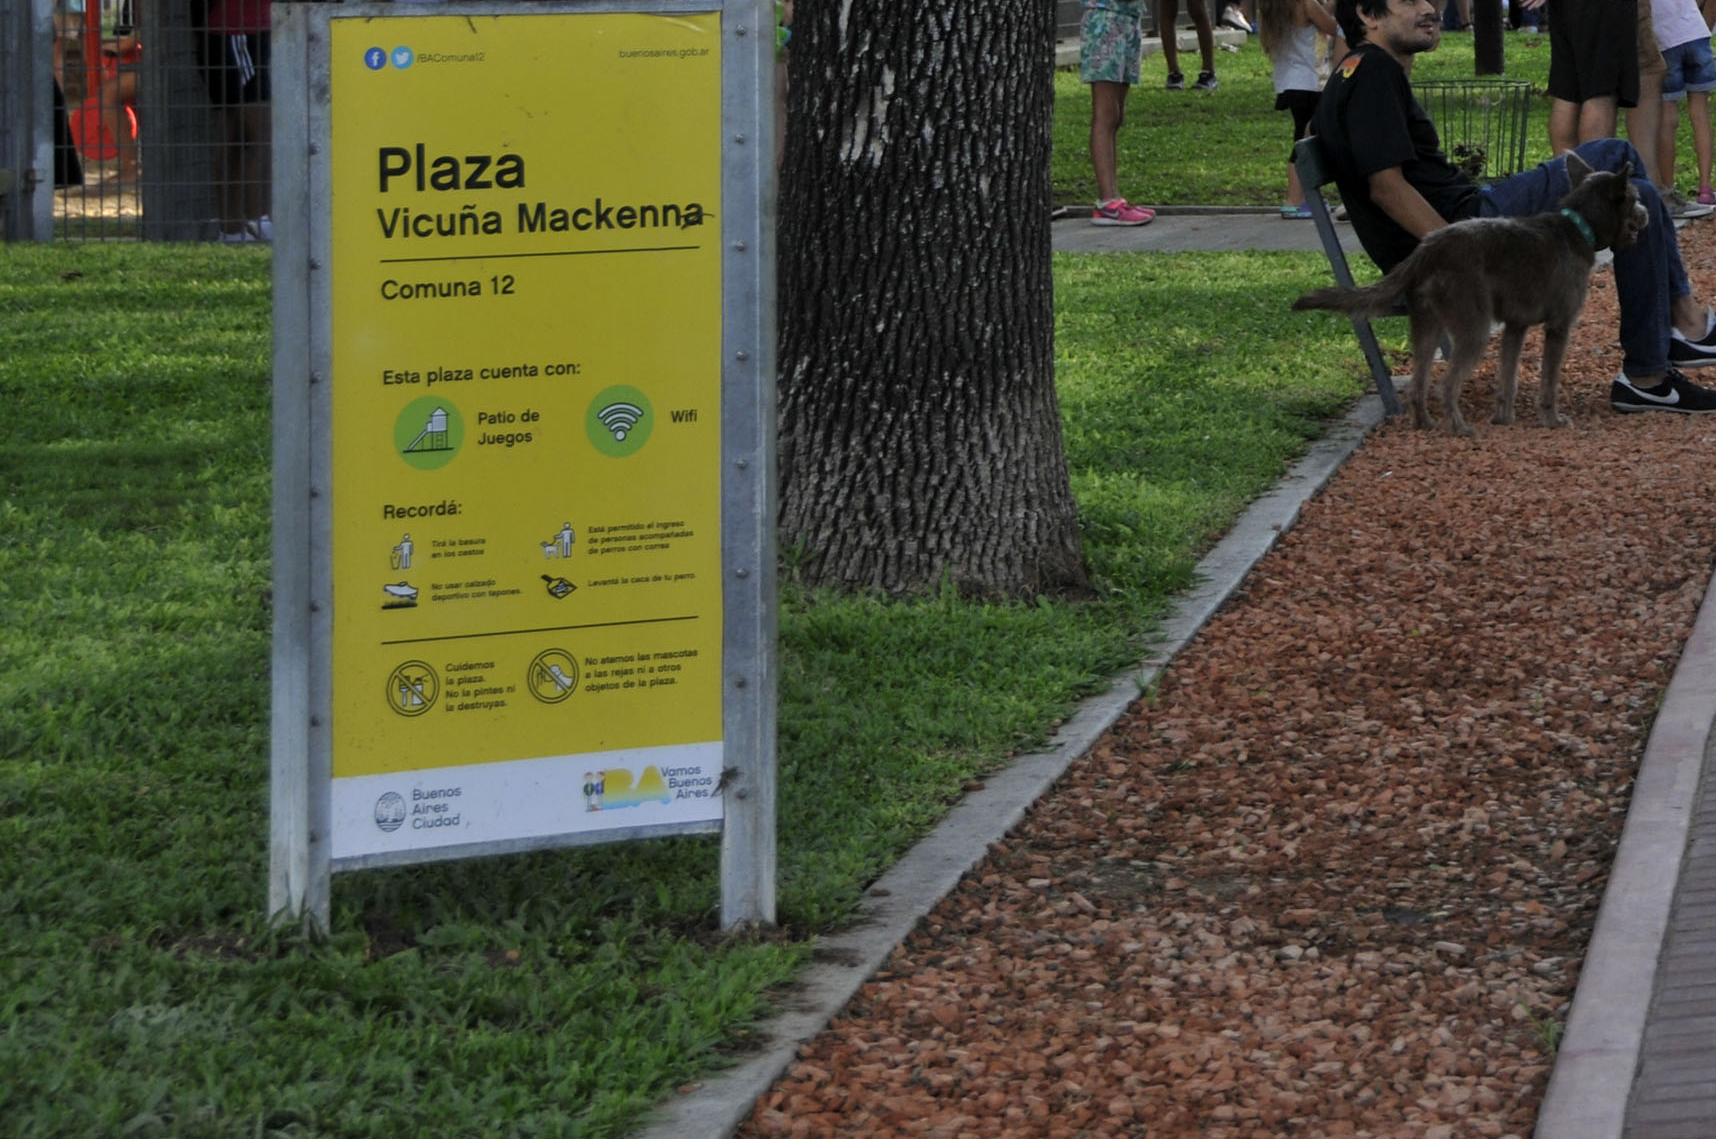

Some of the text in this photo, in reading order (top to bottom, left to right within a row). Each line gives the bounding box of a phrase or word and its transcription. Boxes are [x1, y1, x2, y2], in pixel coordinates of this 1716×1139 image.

[416, 51, 485, 64] /BAComuna12
[619, 47, 710, 60] buenosaires.gob.ar
[379, 142, 526, 193] Plaza
[377, 197, 704, 239] Vicuña Mackenna
[381, 274, 515, 300] Comuna 12
[383, 362, 581, 387] Esta plaza cuenta con:
[478, 409, 540, 425] Patio de
[670, 409, 698, 424] Wifi
[477, 430, 533, 447] Juegos
[383, 500, 463, 520] Recordá:
[607, 523, 645, 533] permitido
[656, 520, 685, 530] ingreso
[449, 539, 457, 547] la
[458, 537, 486, 546] basura
[588, 536, 598, 544] de
[600, 535, 637, 545] personas
[431, 551, 443, 559] en
[444, 550, 456, 558] los
[588, 542, 670, 555] de perros con correa
[431, 579, 496, 591] No usar calzado
[621, 576, 629, 584] la
[630, 575, 650, 584] caca
[651, 574, 662, 582] de
[664, 573, 673, 581] tu
[431, 591, 470, 602] deportivo
[471, 590, 487, 599] con
[585, 656, 598, 666] No
[637, 652, 651, 661] las
[653, 649, 699, 659] mascotas
[445, 661, 496, 672] Cuidemos
[585, 663, 682, 679] a las rejas ni a otros
[445, 675, 487, 687] la plaza.
[585, 676, 678, 694] objetos de la plaza.
[445, 683, 517, 699] No la pintes ni
[445, 699, 508, 713] la destruyas.
[660, 765, 702, 777] Vamos
[668, 776, 713, 789] Buenos
[412, 786, 462, 801] Buenos
[675, 788, 709, 800] Aires
[412, 803, 449, 816] Aires
[412, 812, 461, 830] Ciudad
